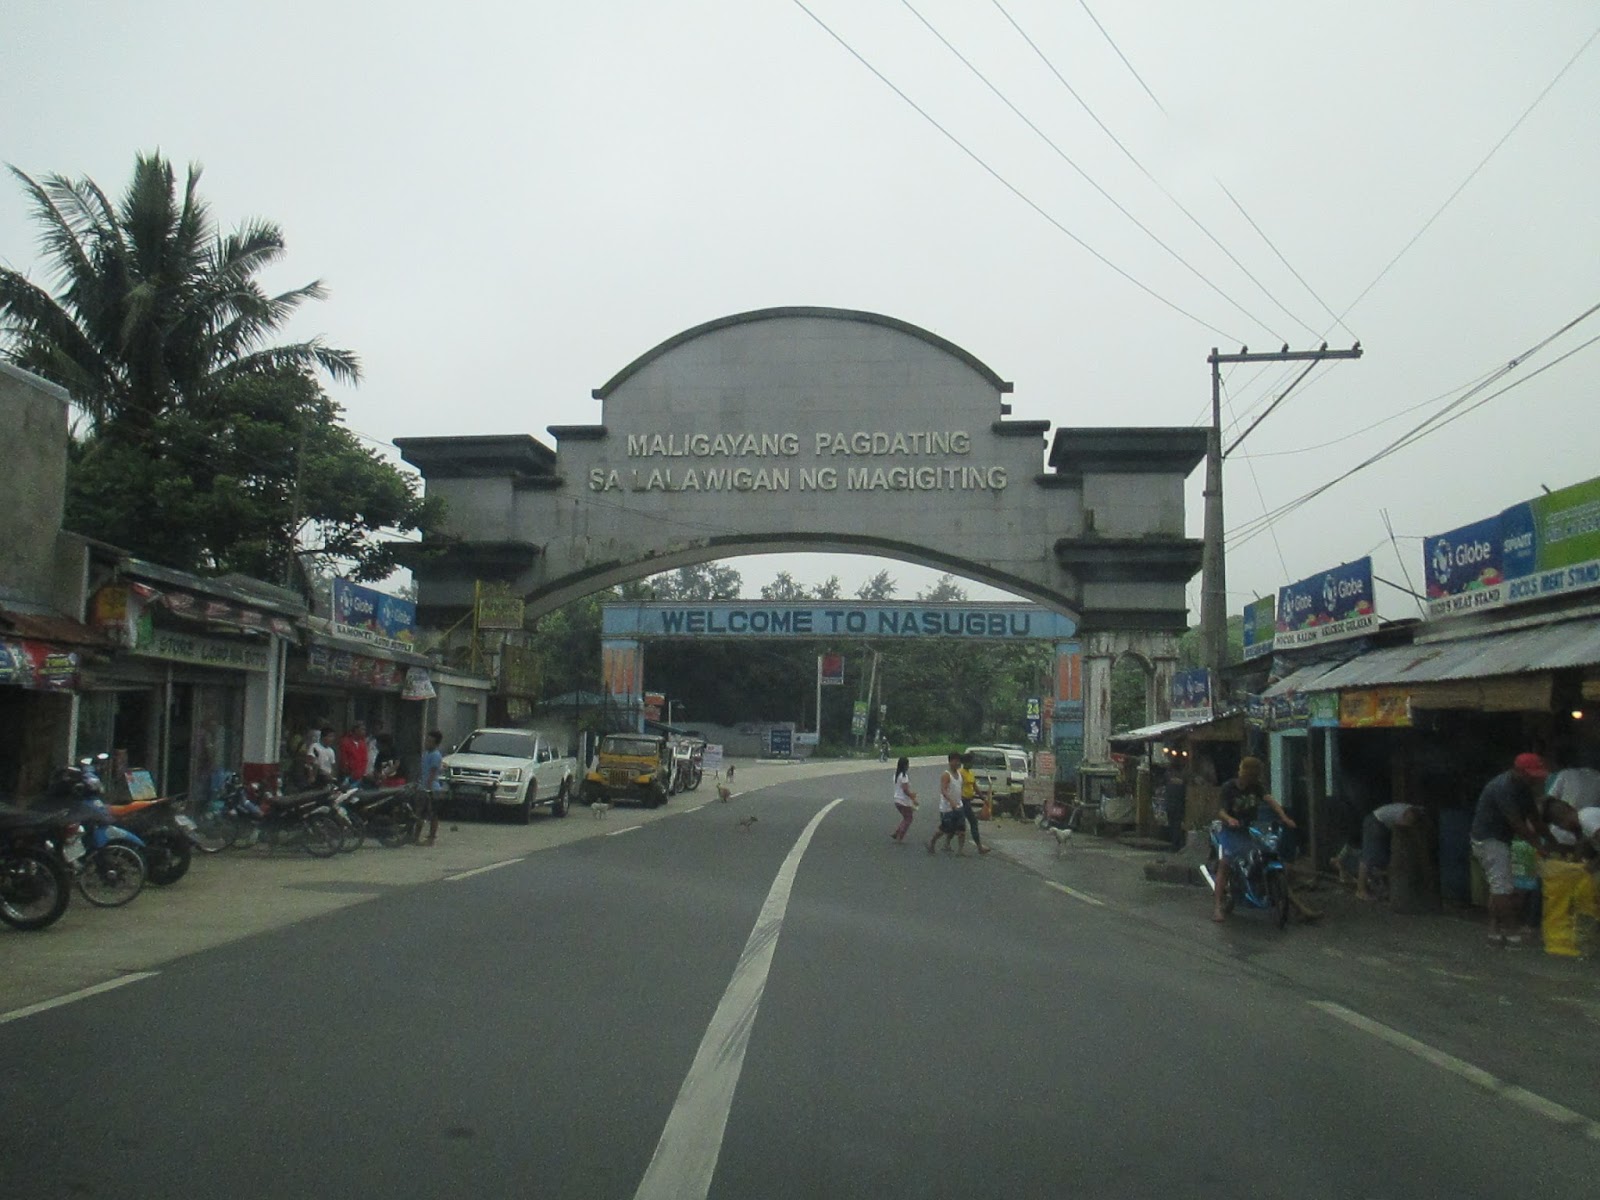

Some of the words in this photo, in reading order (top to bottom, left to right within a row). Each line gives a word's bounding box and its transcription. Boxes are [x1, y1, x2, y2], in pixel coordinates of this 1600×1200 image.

[627, 433, 799, 457] MALIGAYANG
[815, 431, 971, 455] PAGDATING
[589, 468, 622, 492] SA
[799, 467, 838, 491] NG
[847, 466, 1007, 491] MAGIGITING
[1456, 540, 1491, 566] Globe
[1338, 578, 1364, 598] Globe
[662, 610, 813, 634] WELCOME
[825, 610, 867, 634] TO
[879, 610, 1031, 636] NASUGBU
[1027, 703, 1040, 715] 24
